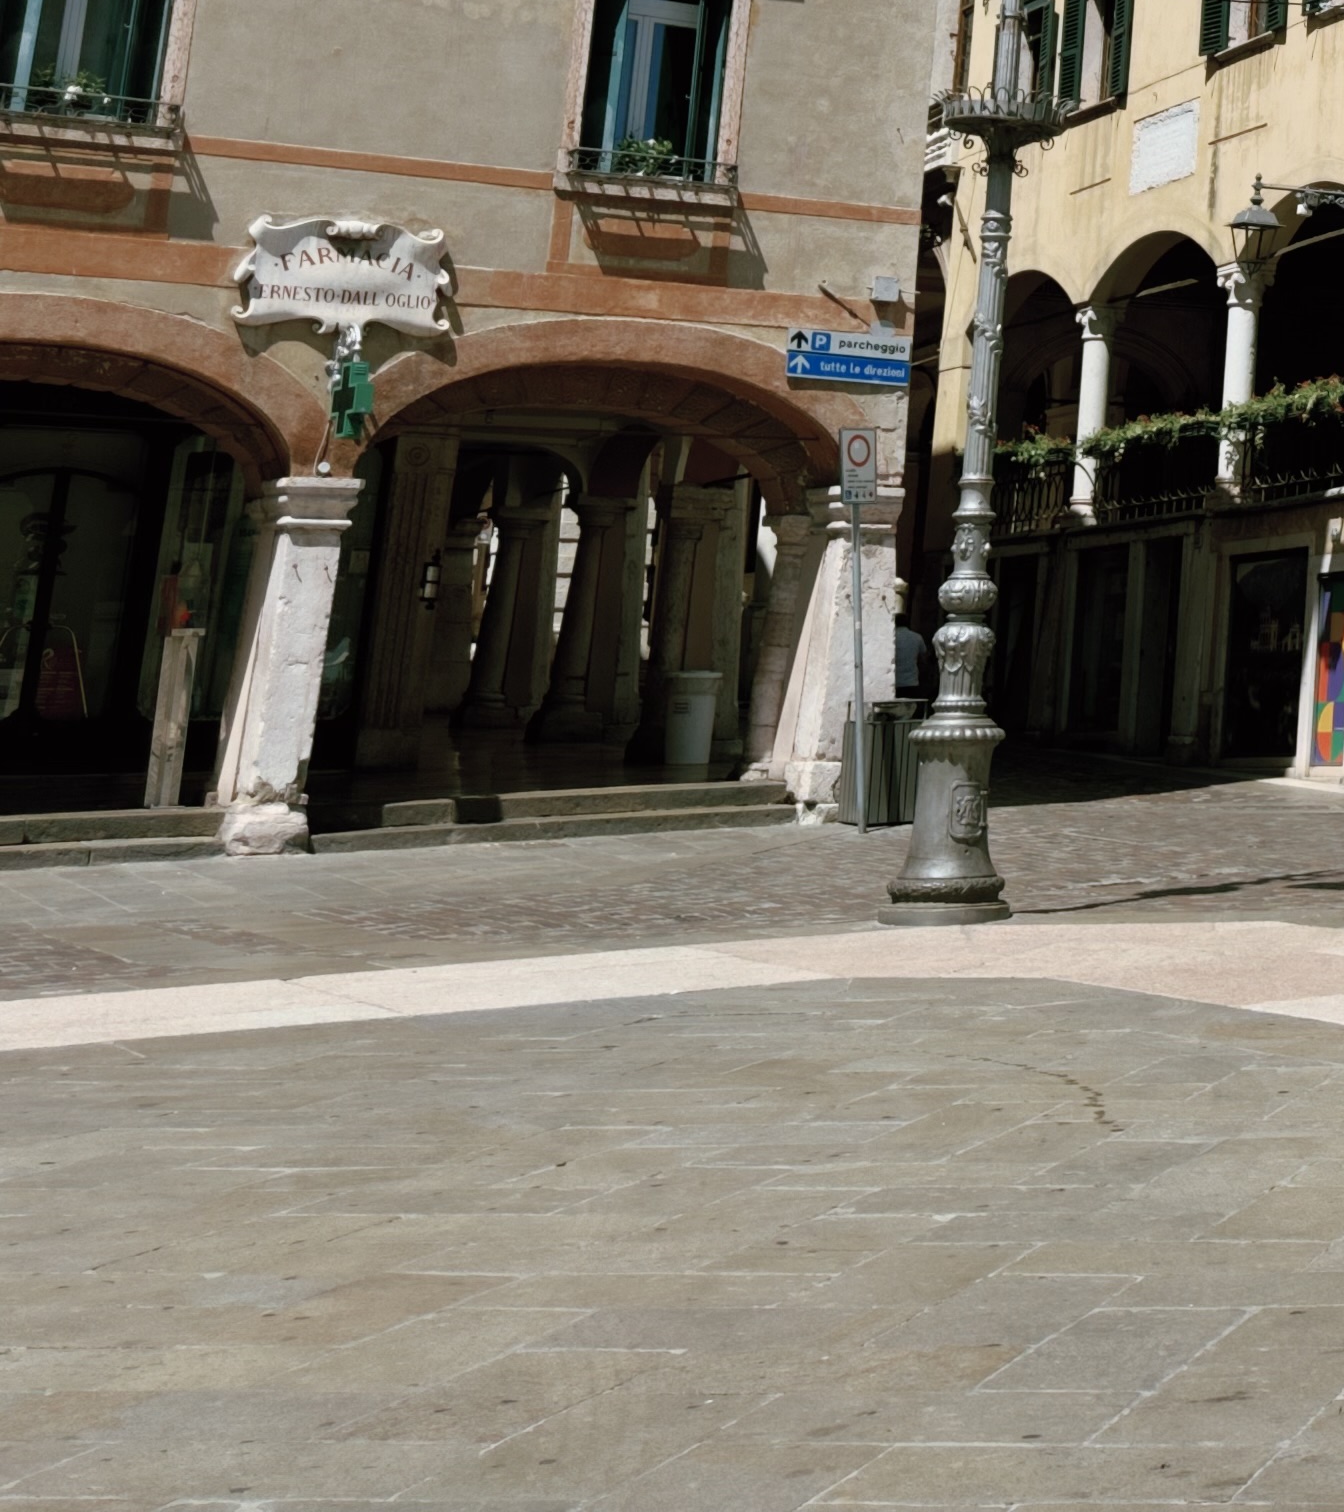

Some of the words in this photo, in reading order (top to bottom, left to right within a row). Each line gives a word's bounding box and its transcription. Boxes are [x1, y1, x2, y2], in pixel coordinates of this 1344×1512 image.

[279, 247, 415, 282] FARMACIA
[259, 283, 335, 303] ERNESTO
[839, 339, 906, 355] parcheggio
[820, 361, 847, 373] tutte
[850, 362, 861, 374] le
[864, 365, 905, 378] direzioni
